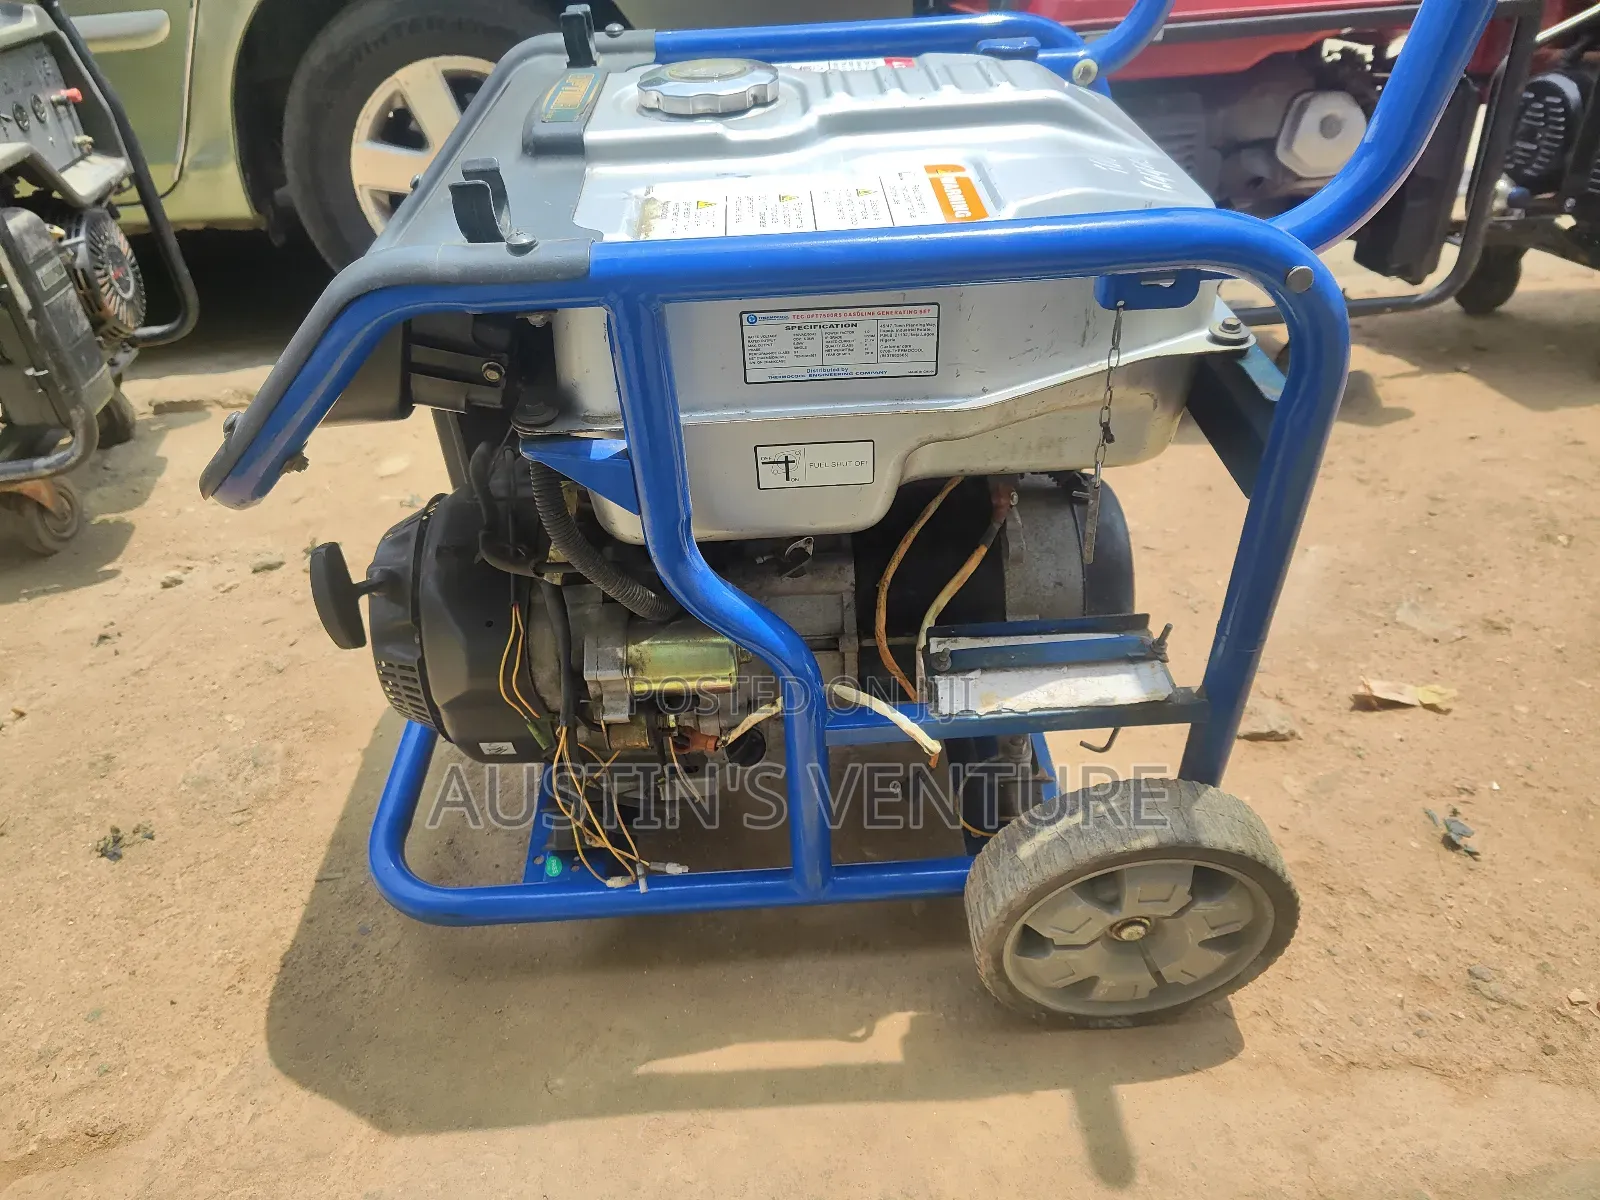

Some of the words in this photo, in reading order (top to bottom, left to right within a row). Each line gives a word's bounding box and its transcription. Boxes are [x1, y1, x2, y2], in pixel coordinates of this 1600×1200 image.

[939, 176, 972, 218] WARNING
[785, 322, 858, 331] SPECIFICATION
[831, 460, 852, 468] SHUT
[551, 859, 559, 875] PASS
